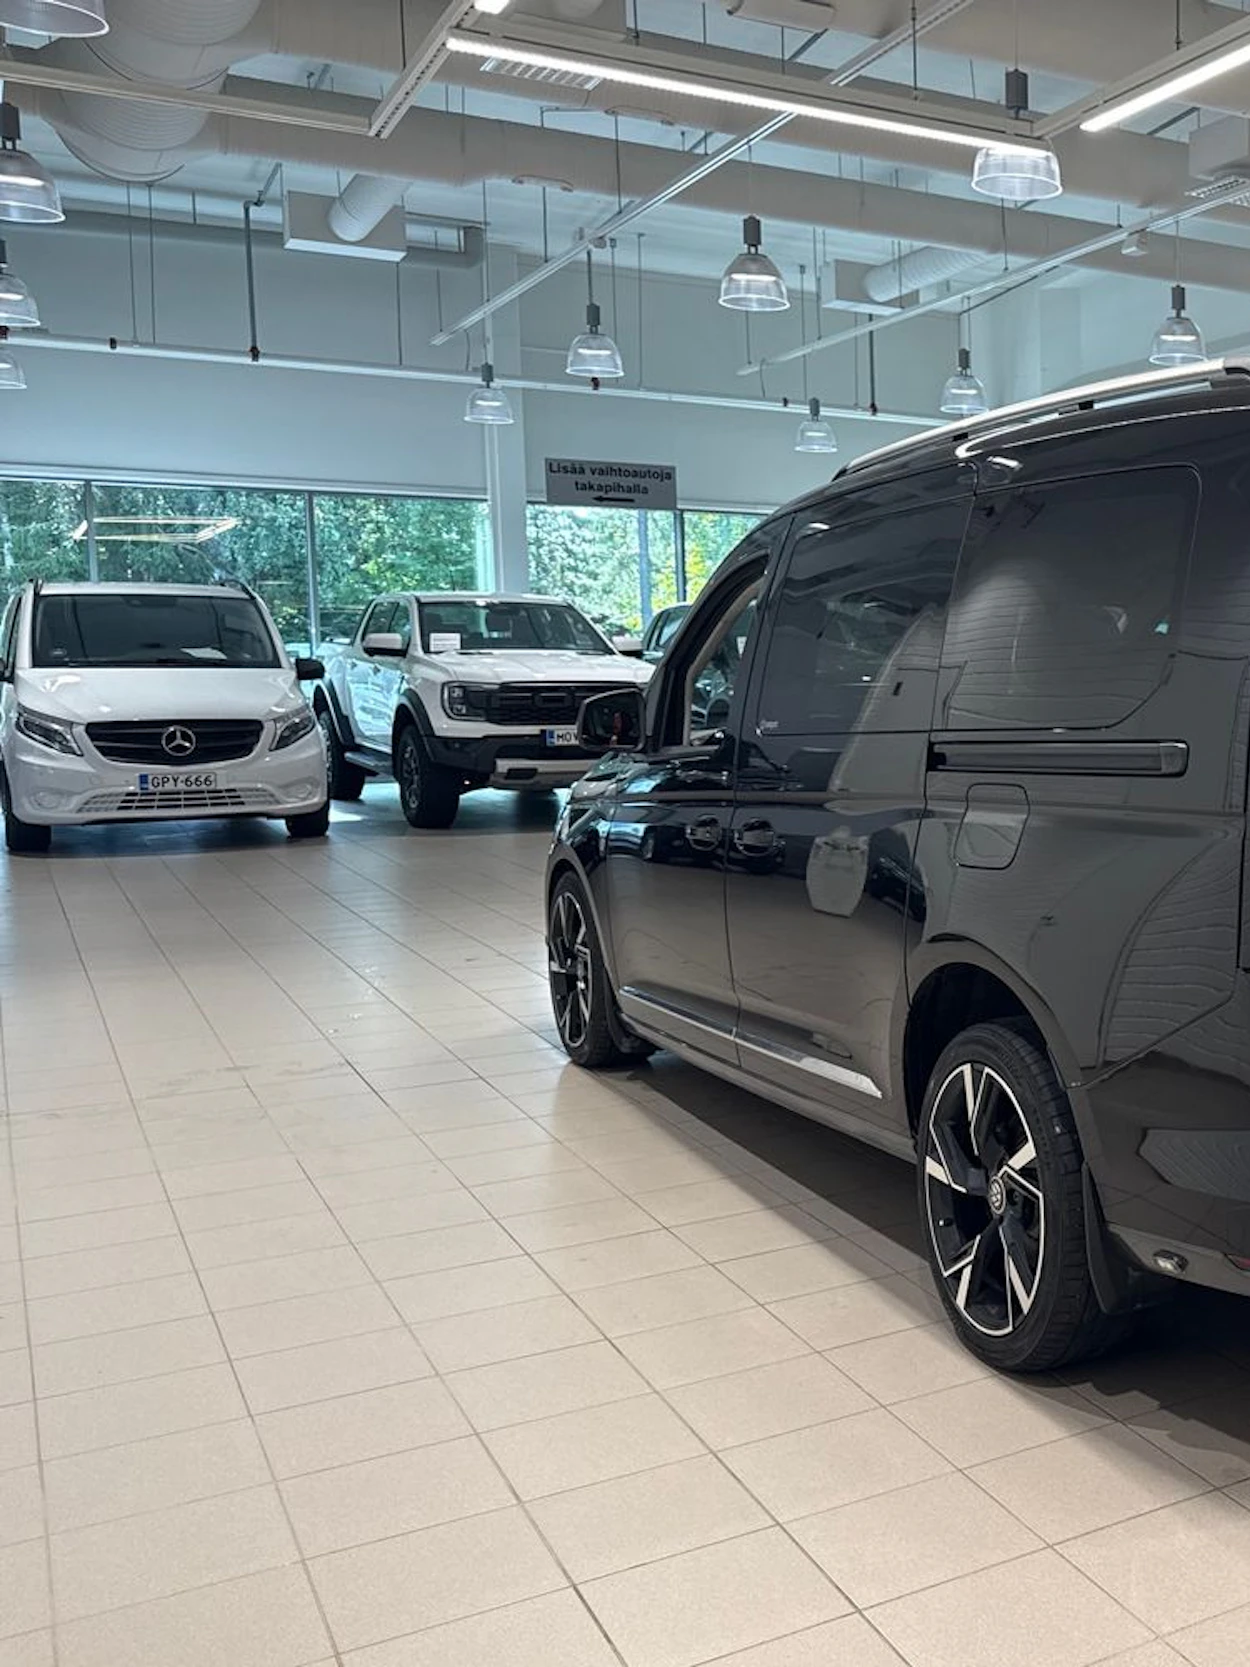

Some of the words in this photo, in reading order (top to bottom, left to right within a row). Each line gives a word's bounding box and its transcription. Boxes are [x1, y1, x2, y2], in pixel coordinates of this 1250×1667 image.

[549, 462, 585, 475] Lisää
[590, 466, 672, 482] vaihtoautoja
[575, 481, 649, 495] takapihalla
[151, 775, 213, 788] GPY-666
